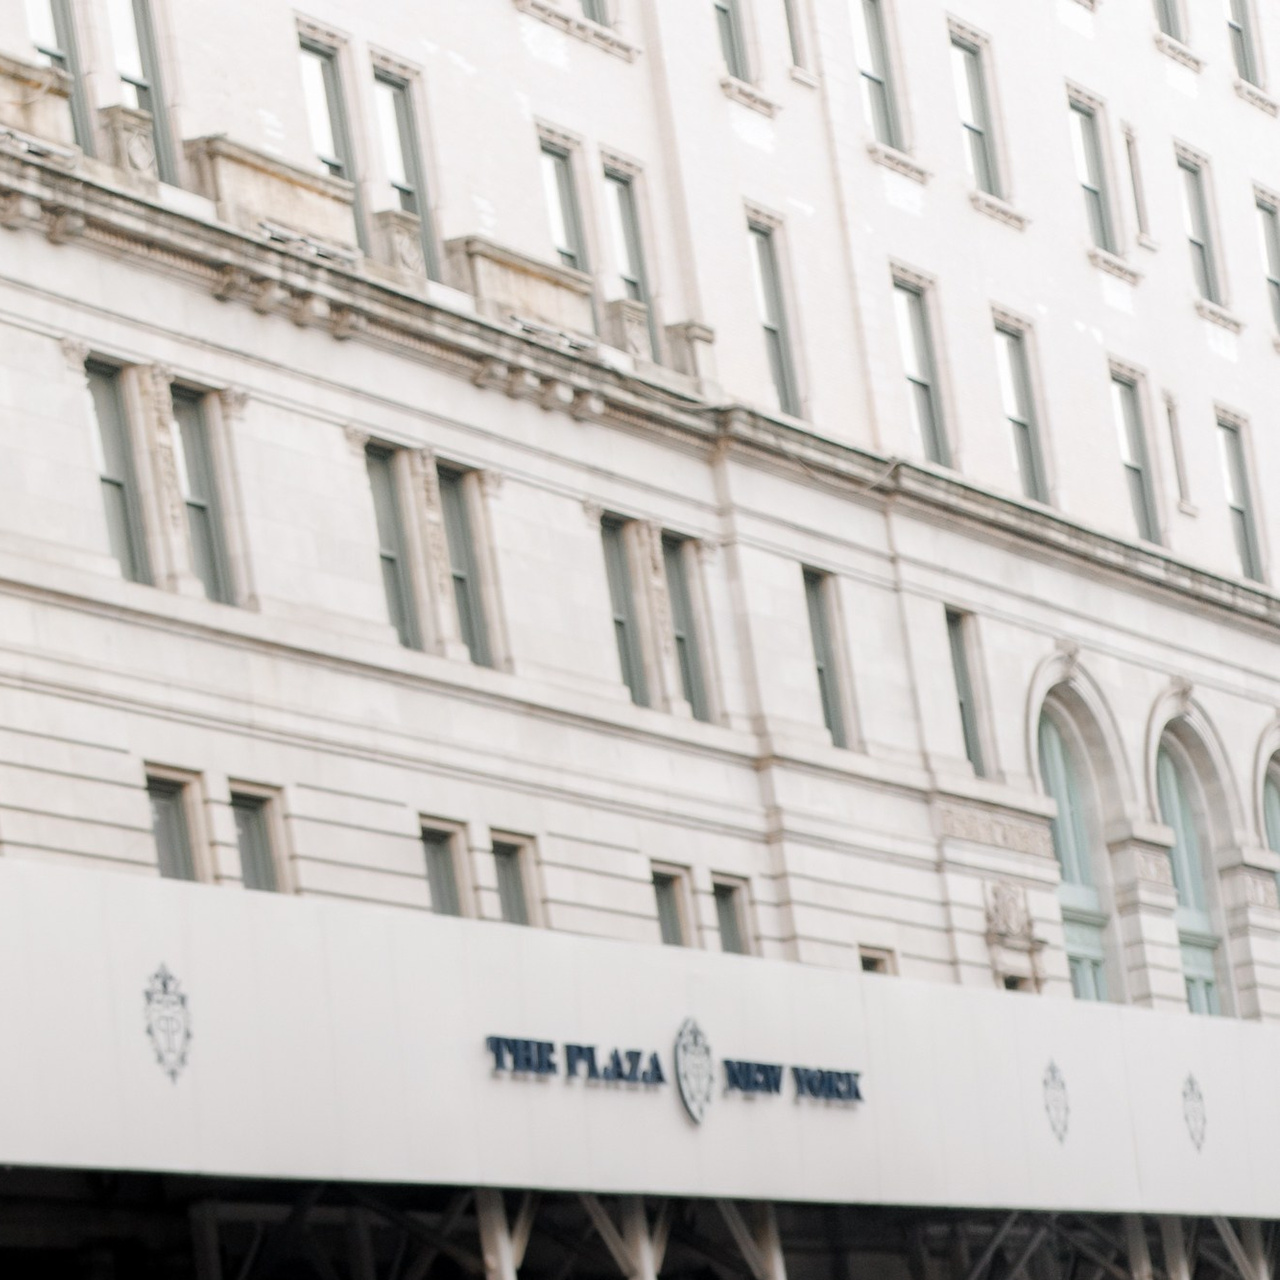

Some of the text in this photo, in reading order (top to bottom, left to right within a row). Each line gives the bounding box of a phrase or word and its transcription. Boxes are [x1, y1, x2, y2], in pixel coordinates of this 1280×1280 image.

[485, 1035, 864, 1101] THE PLAZA NEW YORK
